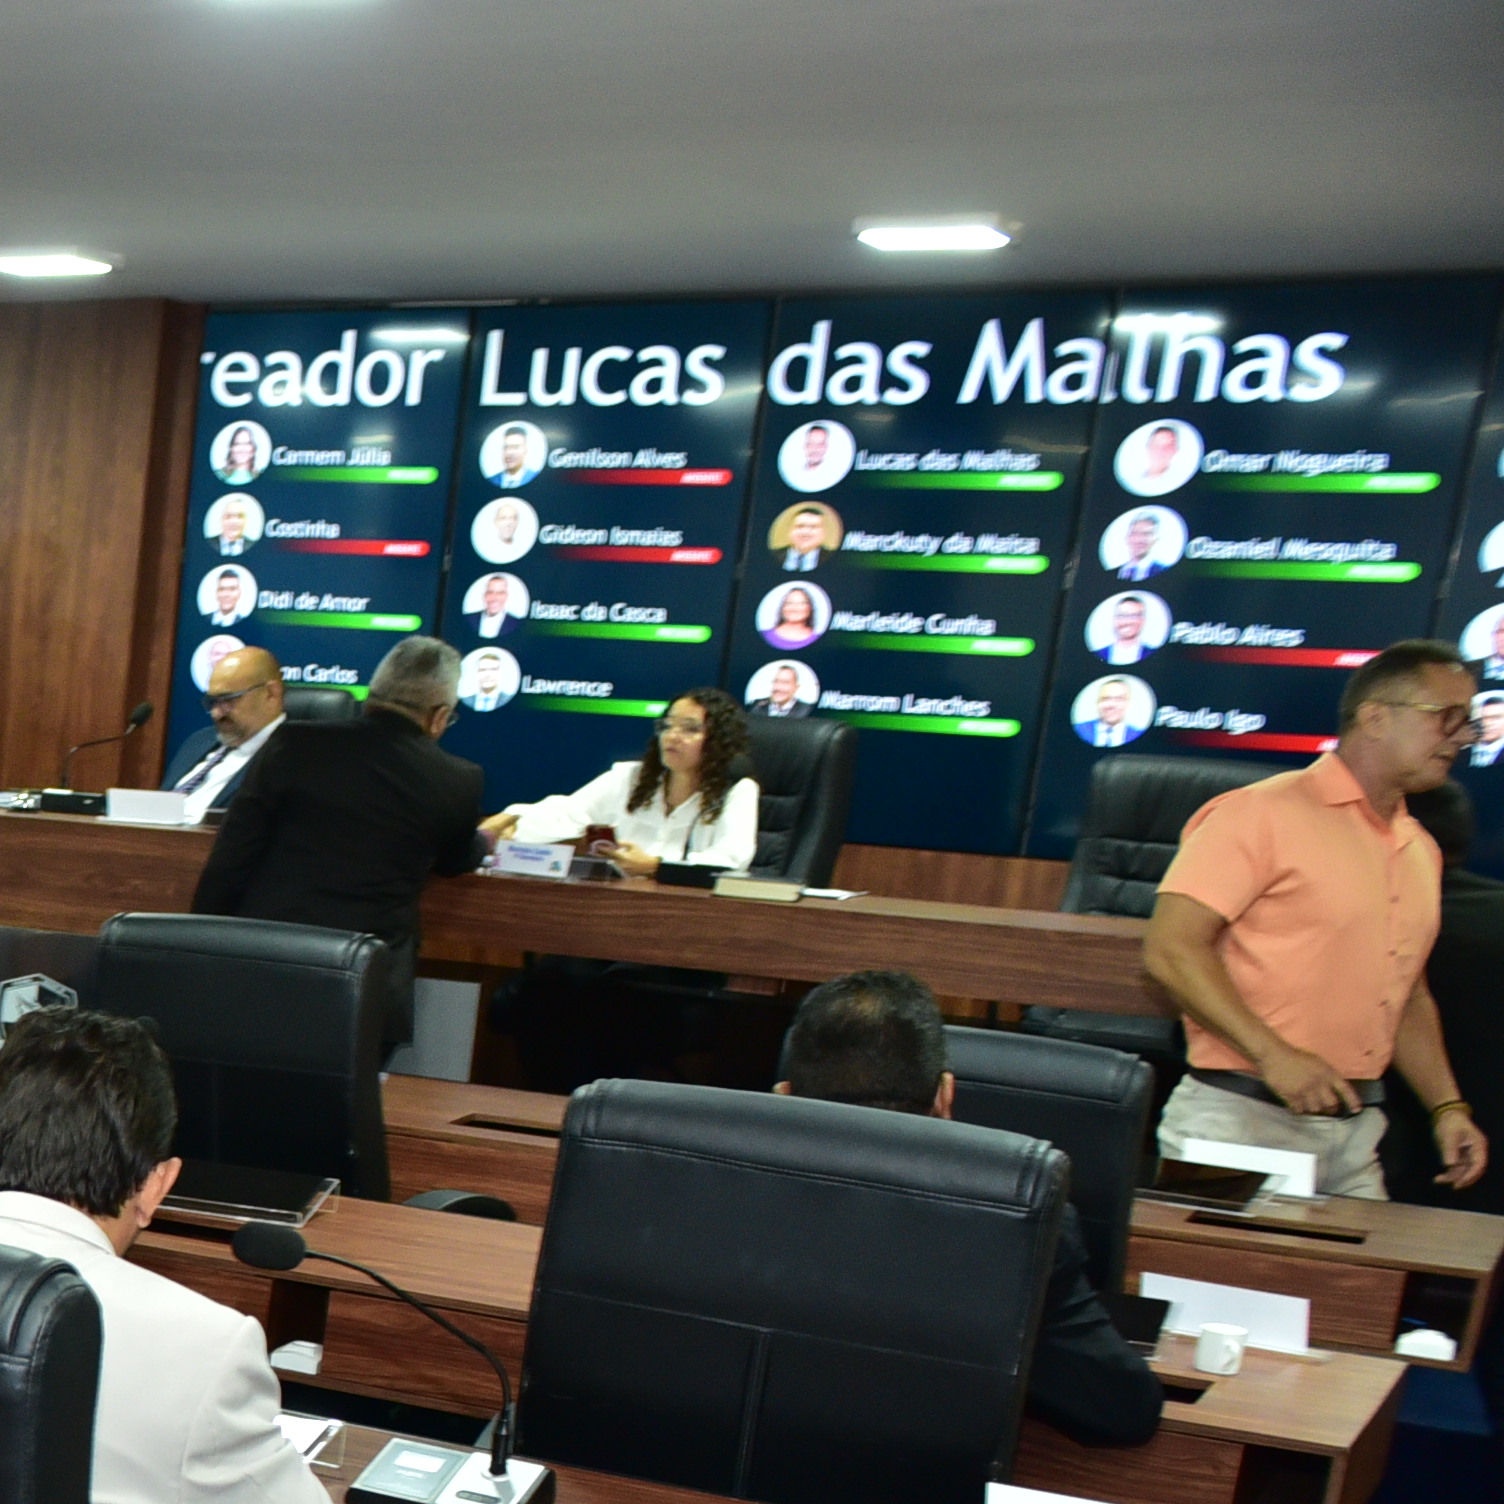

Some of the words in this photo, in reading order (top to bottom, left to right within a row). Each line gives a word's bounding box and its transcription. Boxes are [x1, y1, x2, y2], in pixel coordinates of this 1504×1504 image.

[200, 329, 447, 407] eador
[479, 328, 728, 408] Lucas
[766, 319, 934, 405] das
[955, 316, 1350, 405] Malhas
[632, 448, 689, 468] Alves
[854, 449, 920, 471] Lucas
[918, 448, 962, 471] das
[959, 449, 1041, 471] Malhas
[1200, 449, 1274, 473] Omar
[924, 613, 997, 636] Cunha
[1169, 621, 1241, 646] Pablo
[1236, 623, 1306, 647] Aires
[302, 663, 358, 684] Carlos
[520, 675, 614, 697] Lawrence
[900, 693, 991, 717] Lanches
[1154, 705, 1223, 730] Paulo
